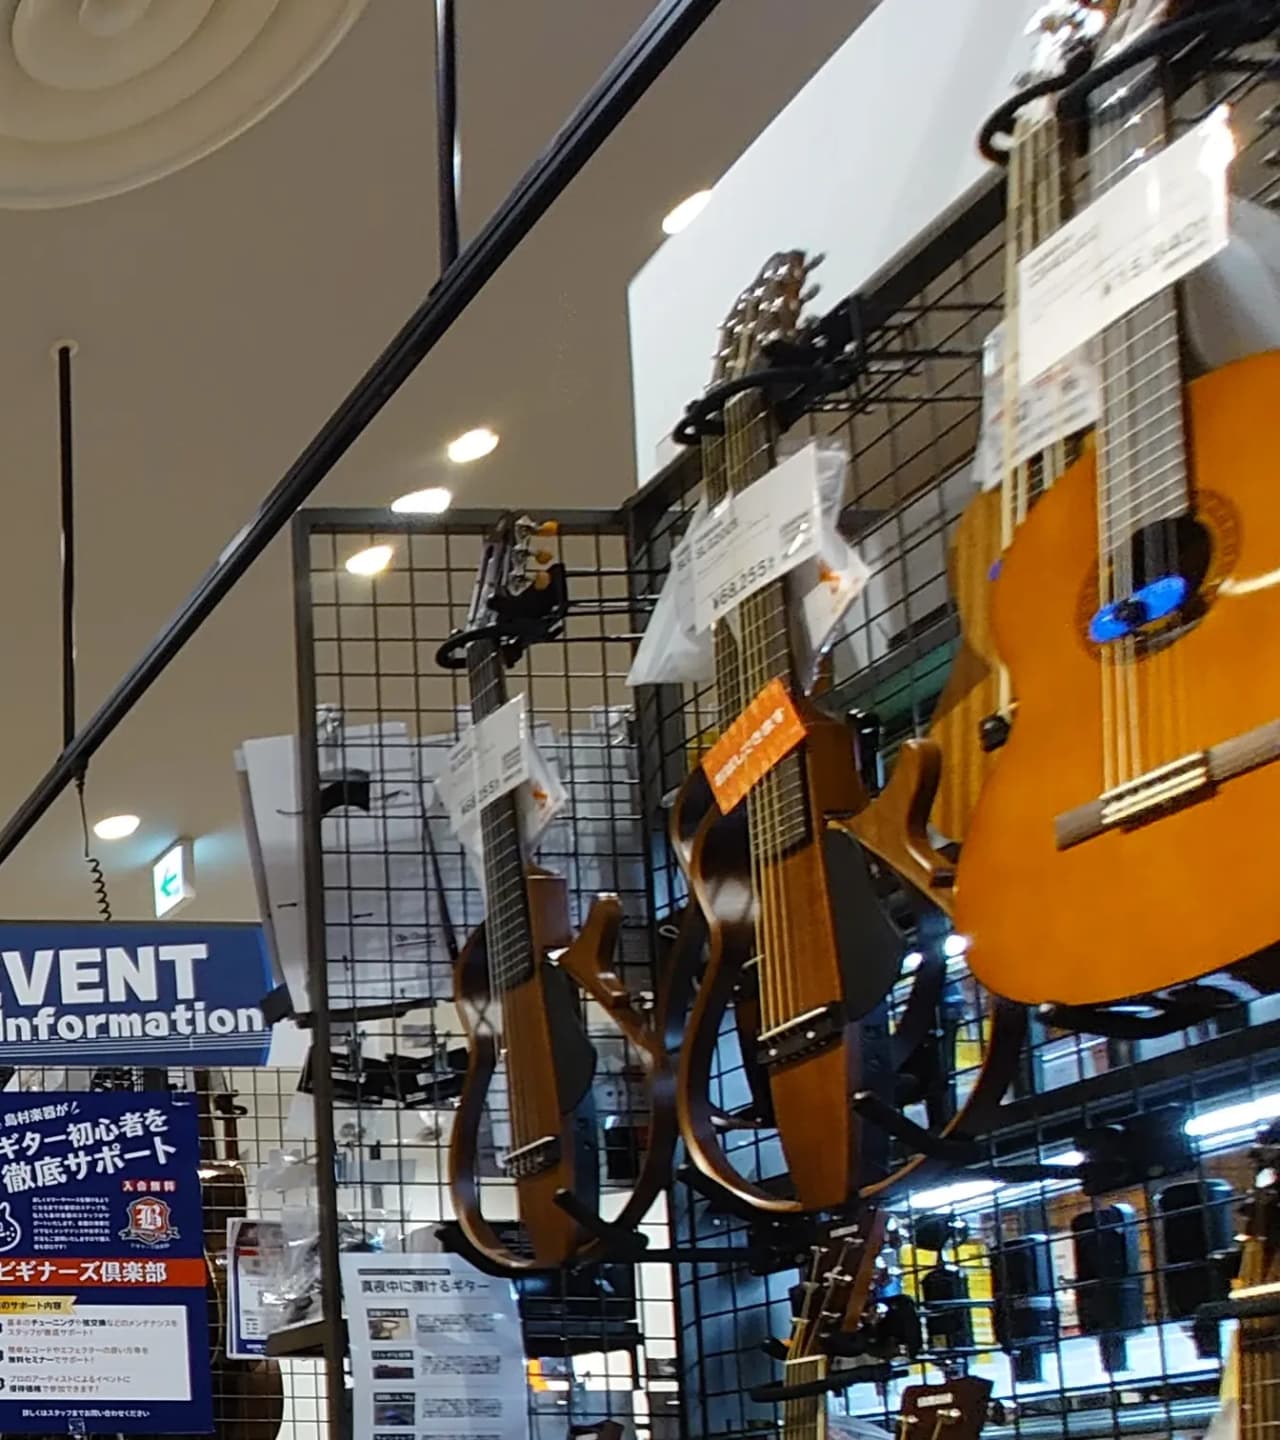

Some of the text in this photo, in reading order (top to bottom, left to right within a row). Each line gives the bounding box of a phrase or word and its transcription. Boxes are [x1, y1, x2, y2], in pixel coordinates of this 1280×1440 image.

[3, 1103, 69, 1128] 島村楽器が
[1, 1135, 177, 1194] 徹底サポート
[360, 1279, 490, 1294] 真夜中に弾けるギター
